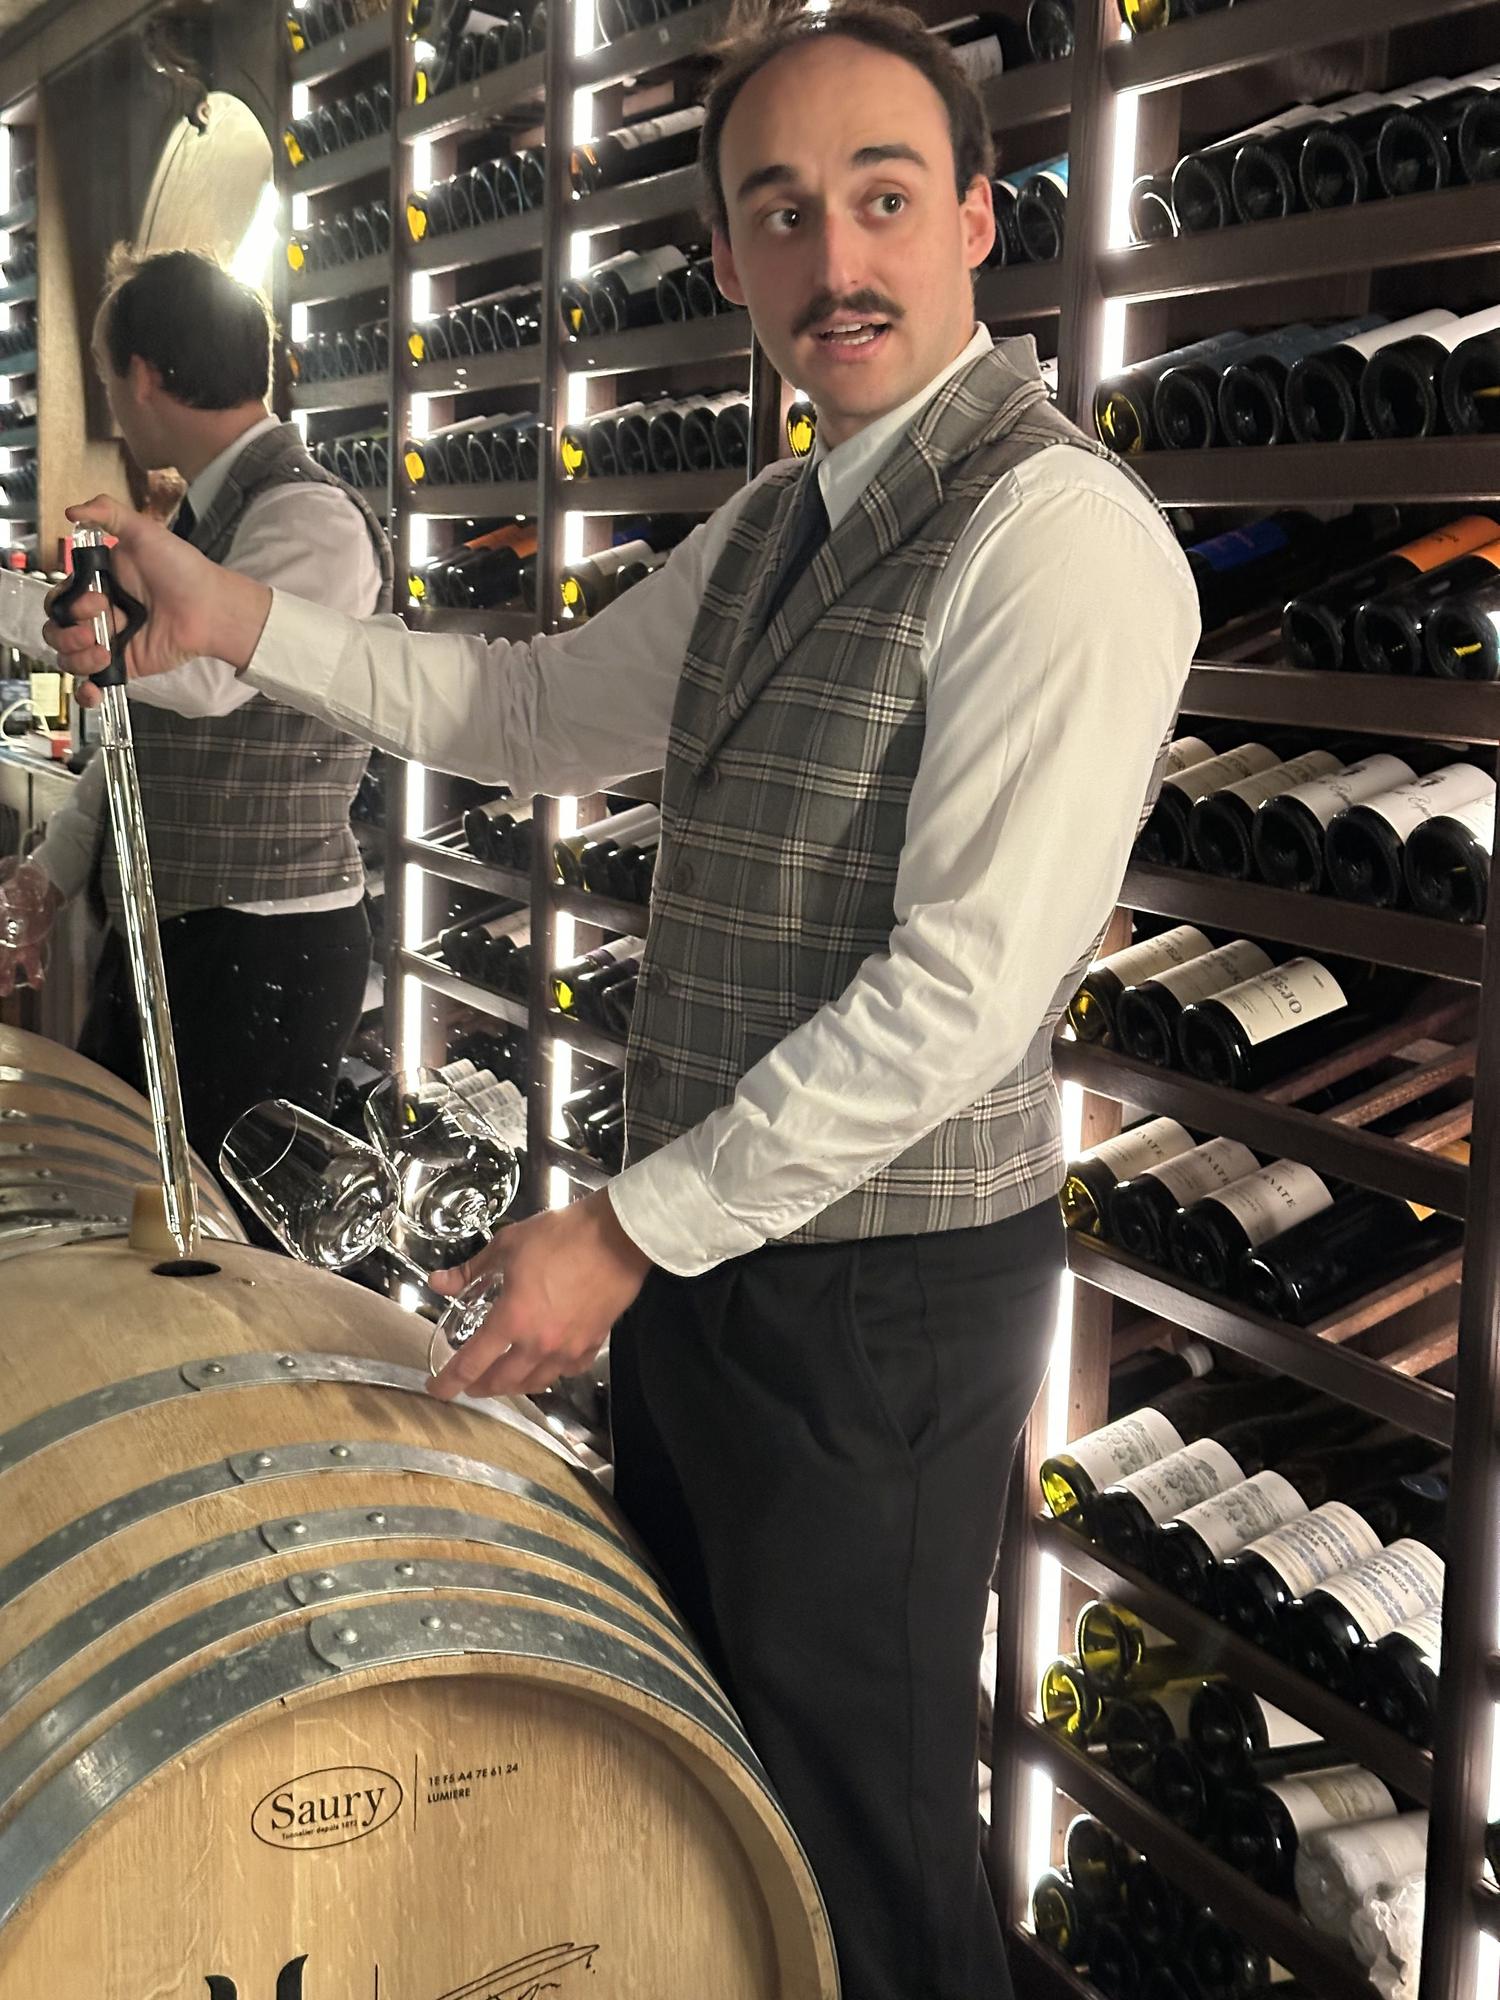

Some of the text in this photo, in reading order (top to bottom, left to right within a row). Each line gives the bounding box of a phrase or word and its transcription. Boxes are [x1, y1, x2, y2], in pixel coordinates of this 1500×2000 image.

[458, 1770, 473, 1782] A4
[490, 1765, 502, 1777] 61
[506, 1763, 519, 1774] 24
[427, 1787, 471, 1803] LUMIERE
[271, 1787, 386, 1831] Saury
